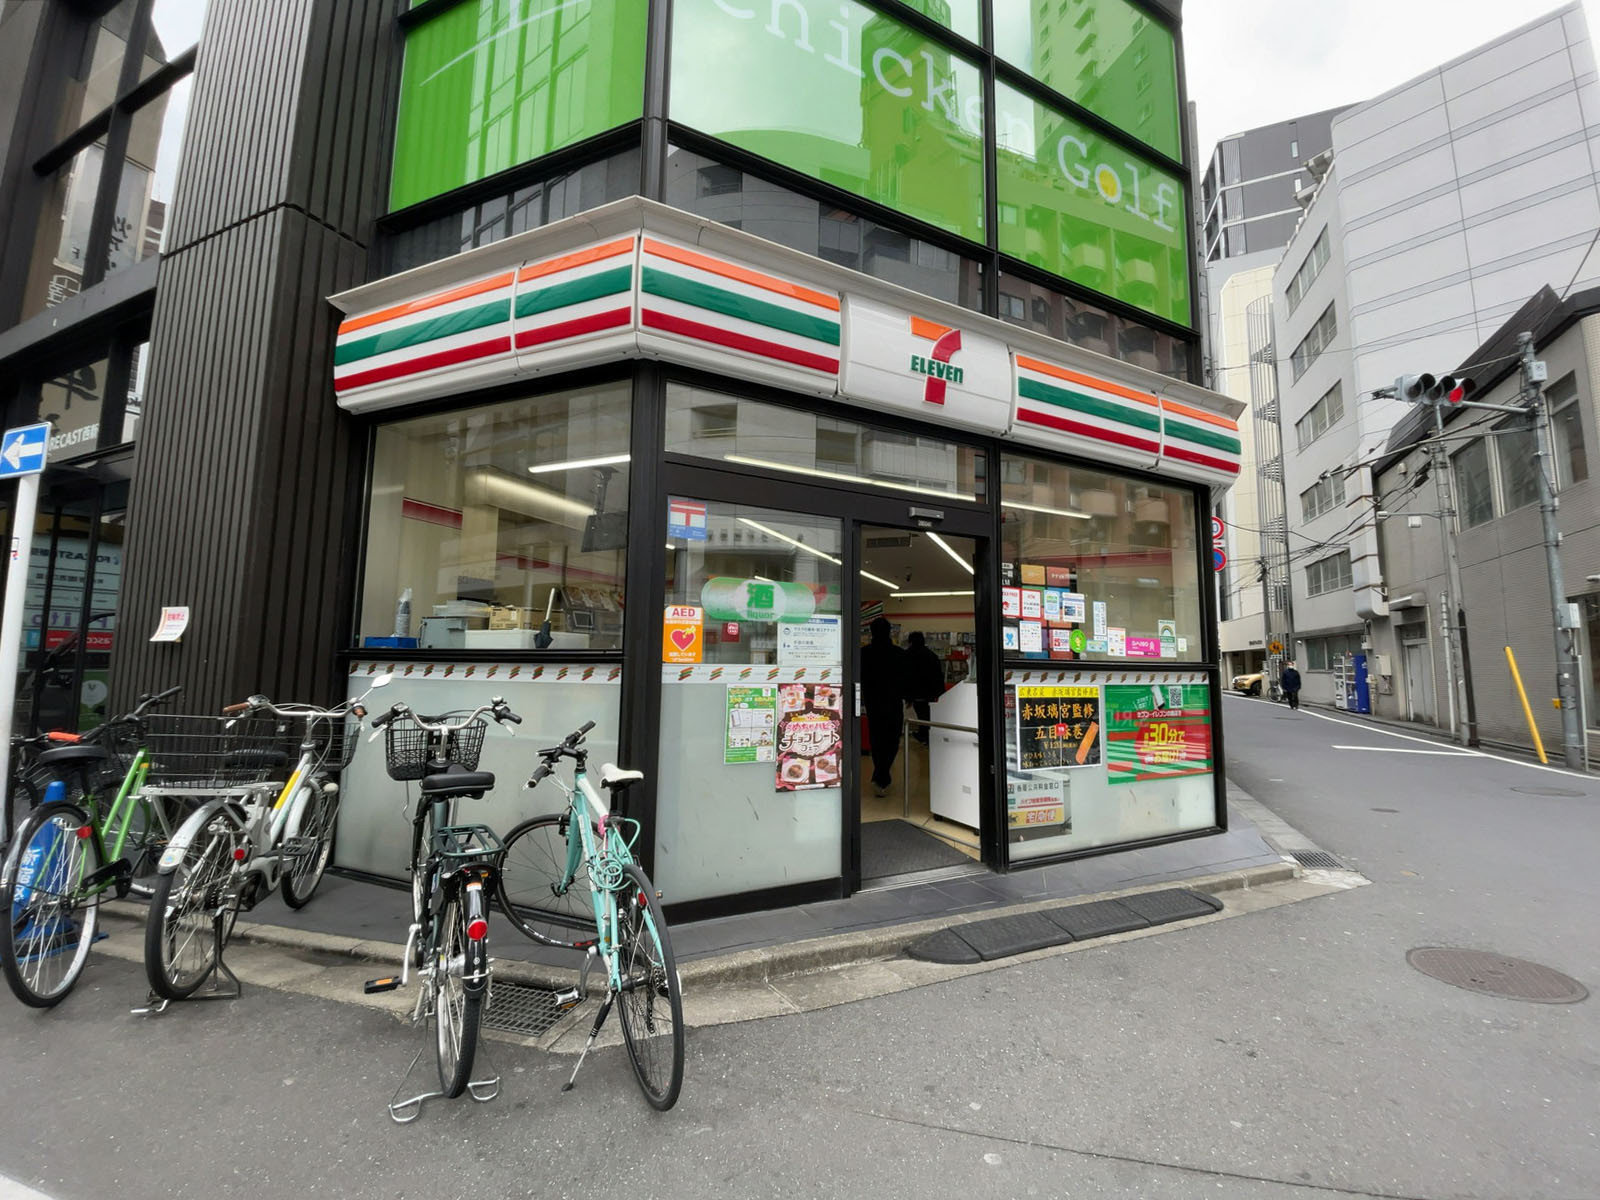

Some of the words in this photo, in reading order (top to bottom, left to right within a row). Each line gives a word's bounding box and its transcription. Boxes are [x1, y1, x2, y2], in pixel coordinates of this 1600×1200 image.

[1057, 134, 1175, 234] Golf
[910, 315, 962, 405] 7
[747, 583, 774, 609] 酒
[671, 607, 696, 618] AED
[746, 609, 775, 621] liquor
[1021, 703, 1095, 721] 赤坂璃宮監修
[780, 730, 840, 751] チョコレート
[801, 744, 819, 752] フェア
